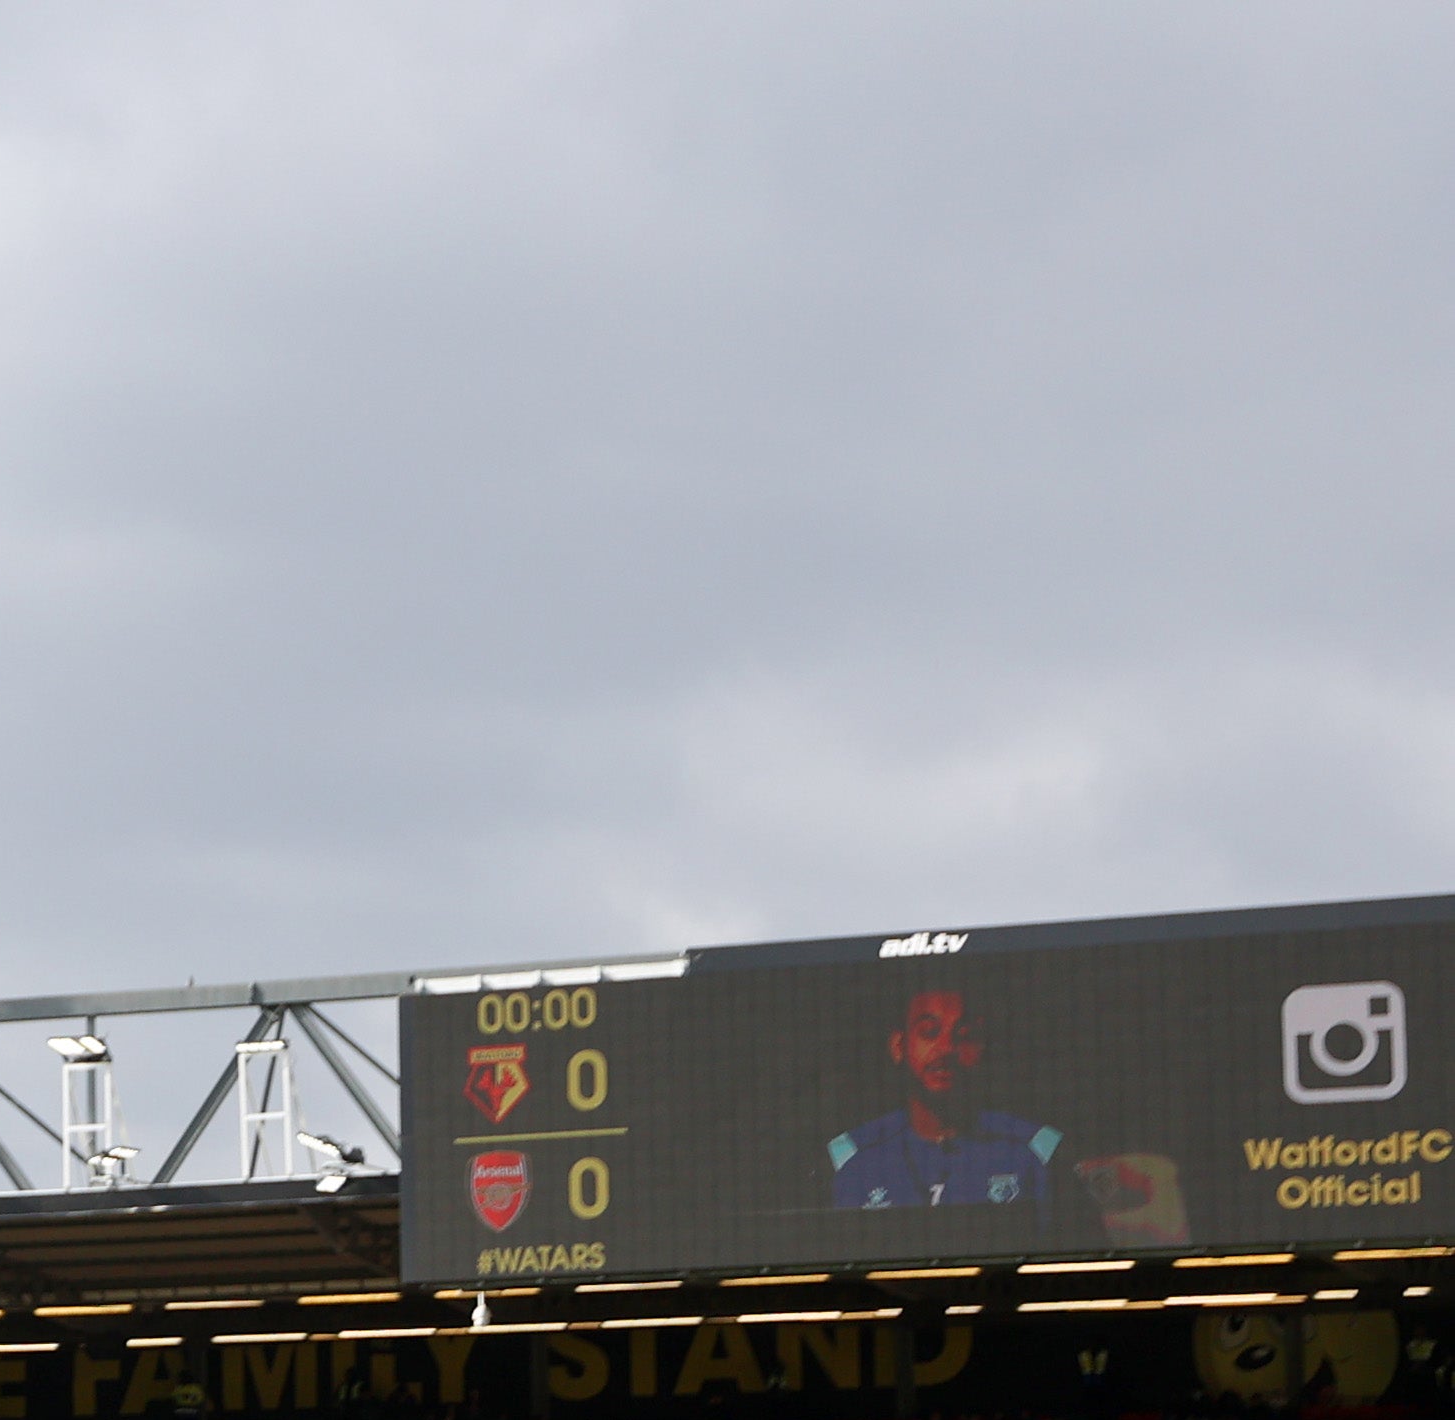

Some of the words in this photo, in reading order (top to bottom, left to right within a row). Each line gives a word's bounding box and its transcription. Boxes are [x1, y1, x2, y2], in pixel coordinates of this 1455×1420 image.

[879, 931, 969, 958] adi.tv
[477, 987, 597, 1034] 00:00
[566, 1048, 608, 1112] 0
[1243, 1128, 1453, 1171] WatfordFC
[569, 1156, 610, 1219] 0
[1276, 1170, 1422, 1209] Official
[477, 1241, 606, 1275] #WATARS
